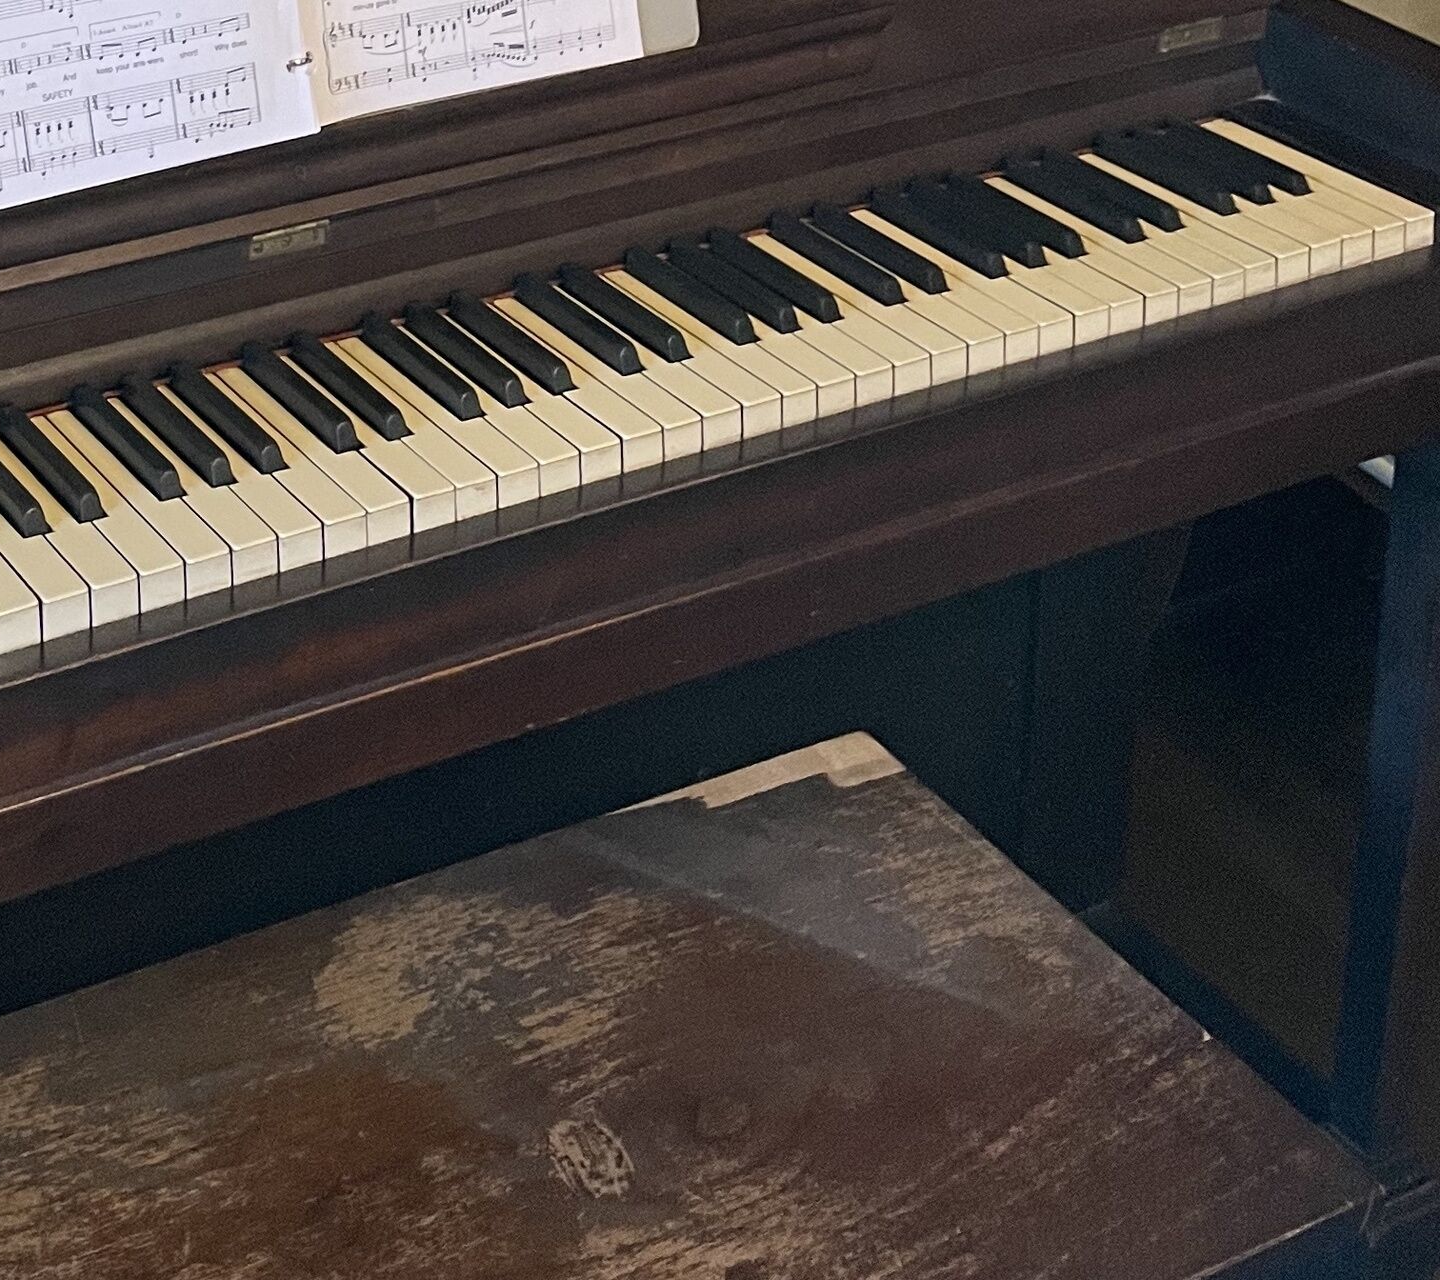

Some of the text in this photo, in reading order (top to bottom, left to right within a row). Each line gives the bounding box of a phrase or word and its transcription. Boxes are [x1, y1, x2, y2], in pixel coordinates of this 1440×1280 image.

[62, 72, 76, 81] And
[96, 66, 112, 75] keep
[115, 63, 129, 72] your
[214, 43, 229, 51] Why
[231, 39, 247, 47] does
[42, 87, 73, 101] SAFETY
